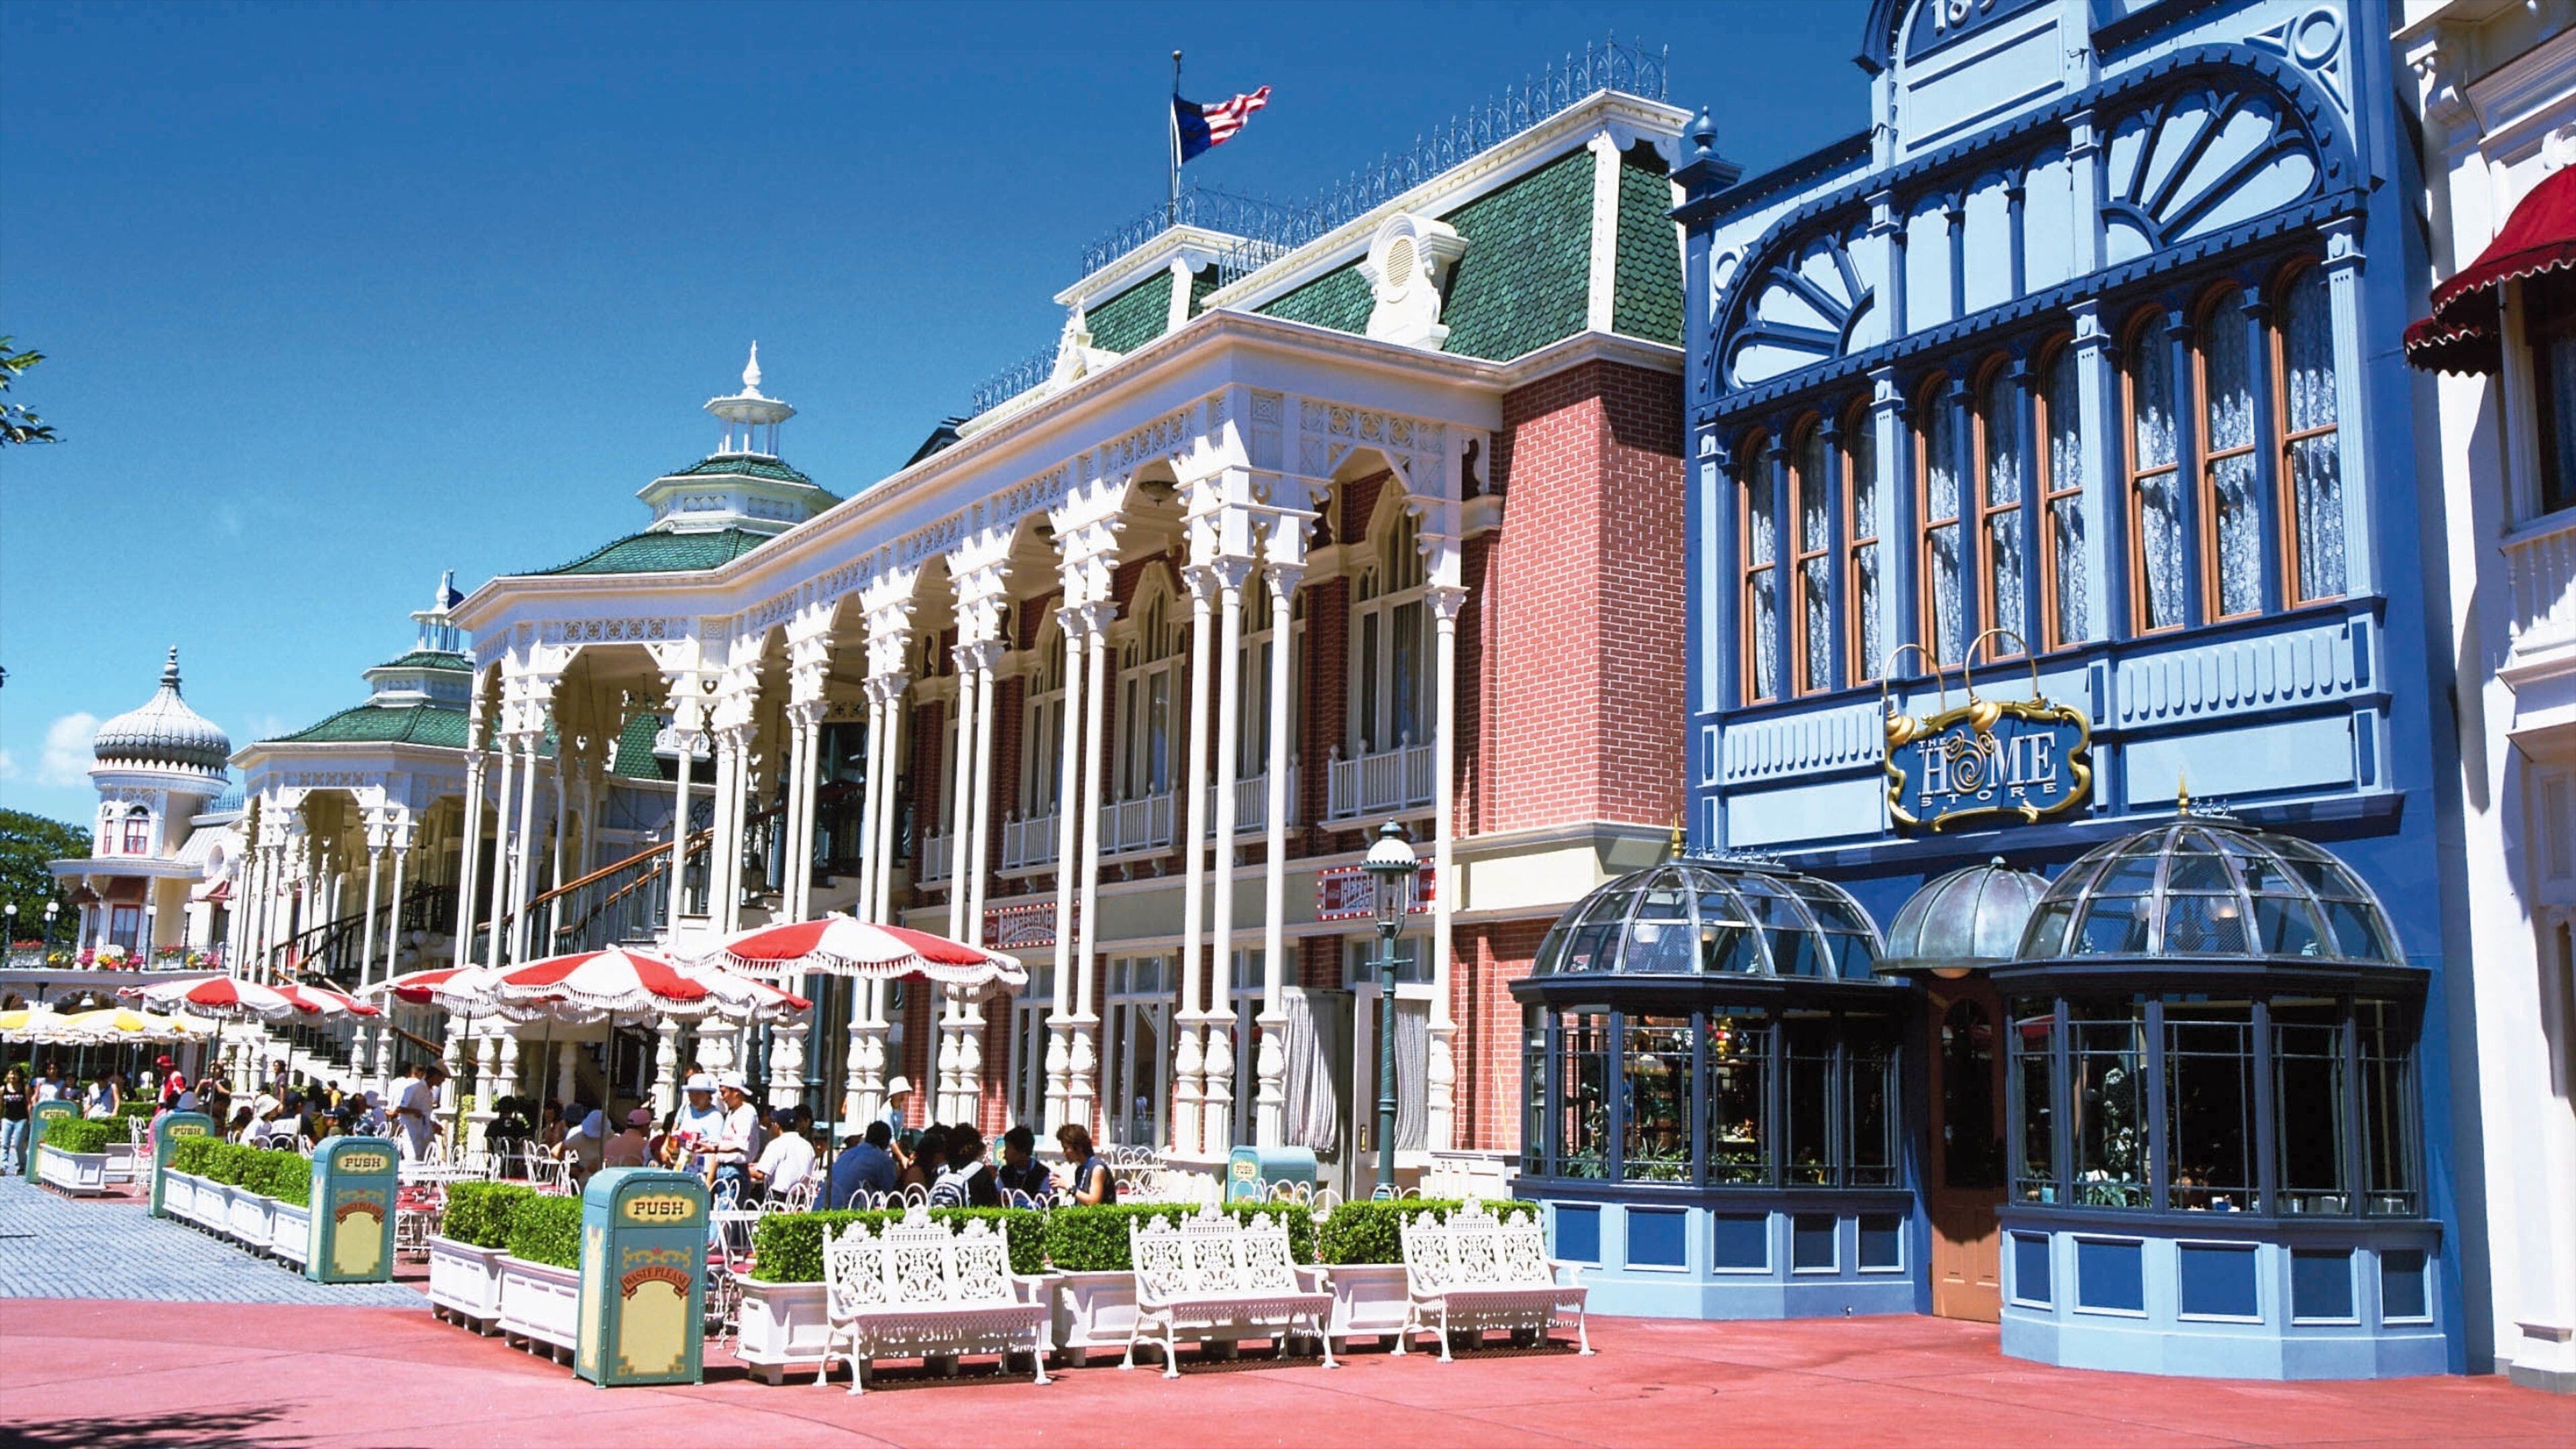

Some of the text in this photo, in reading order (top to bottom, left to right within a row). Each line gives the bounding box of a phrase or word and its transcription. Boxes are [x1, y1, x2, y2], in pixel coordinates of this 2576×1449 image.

[1917, 737, 1947, 748] THE
[1917, 731, 2056, 795] HOME
[1921, 783, 2057, 807] STORE
[1002, 908, 1057, 942] REFRESHMEN
[345, 1157, 380, 1167] PUSH
[634, 1201, 684, 1215] PUSH
[623, 1266, 690, 1286] WASTE PLEASE
